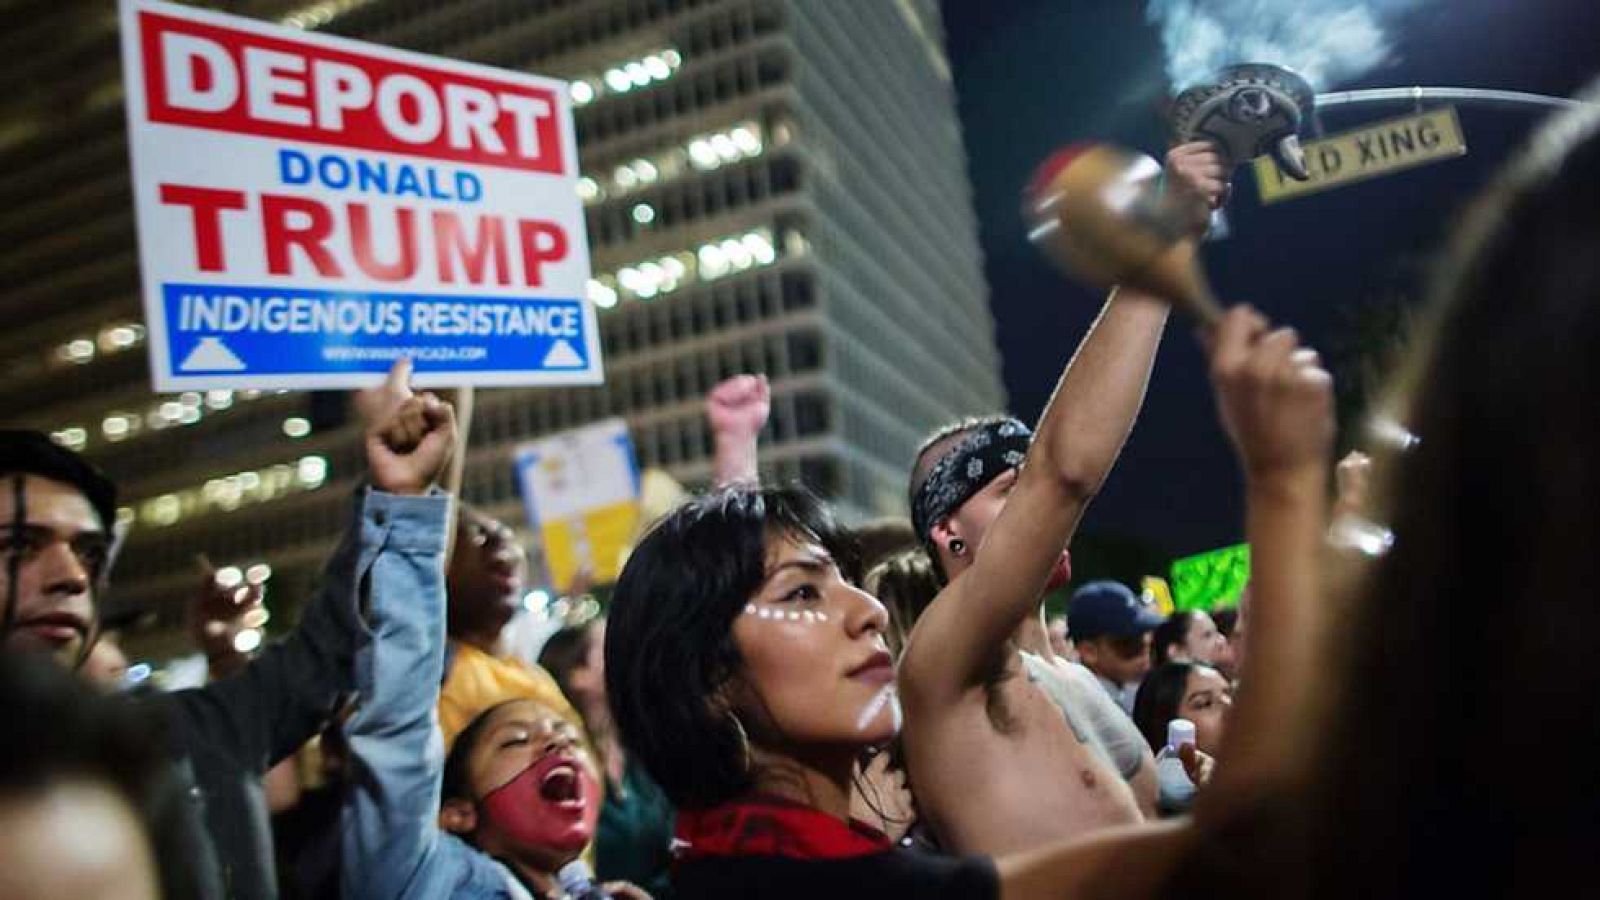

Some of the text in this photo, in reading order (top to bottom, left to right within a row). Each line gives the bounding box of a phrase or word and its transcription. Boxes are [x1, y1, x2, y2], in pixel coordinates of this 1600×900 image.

[160, 31, 551, 159] DEPORT
[1357, 118, 1441, 166] XING
[279, 149, 484, 203] DONALD
[158, 183, 570, 288] TRUMP
[178, 295, 579, 337] INDIGENOUS RESISTANCE
